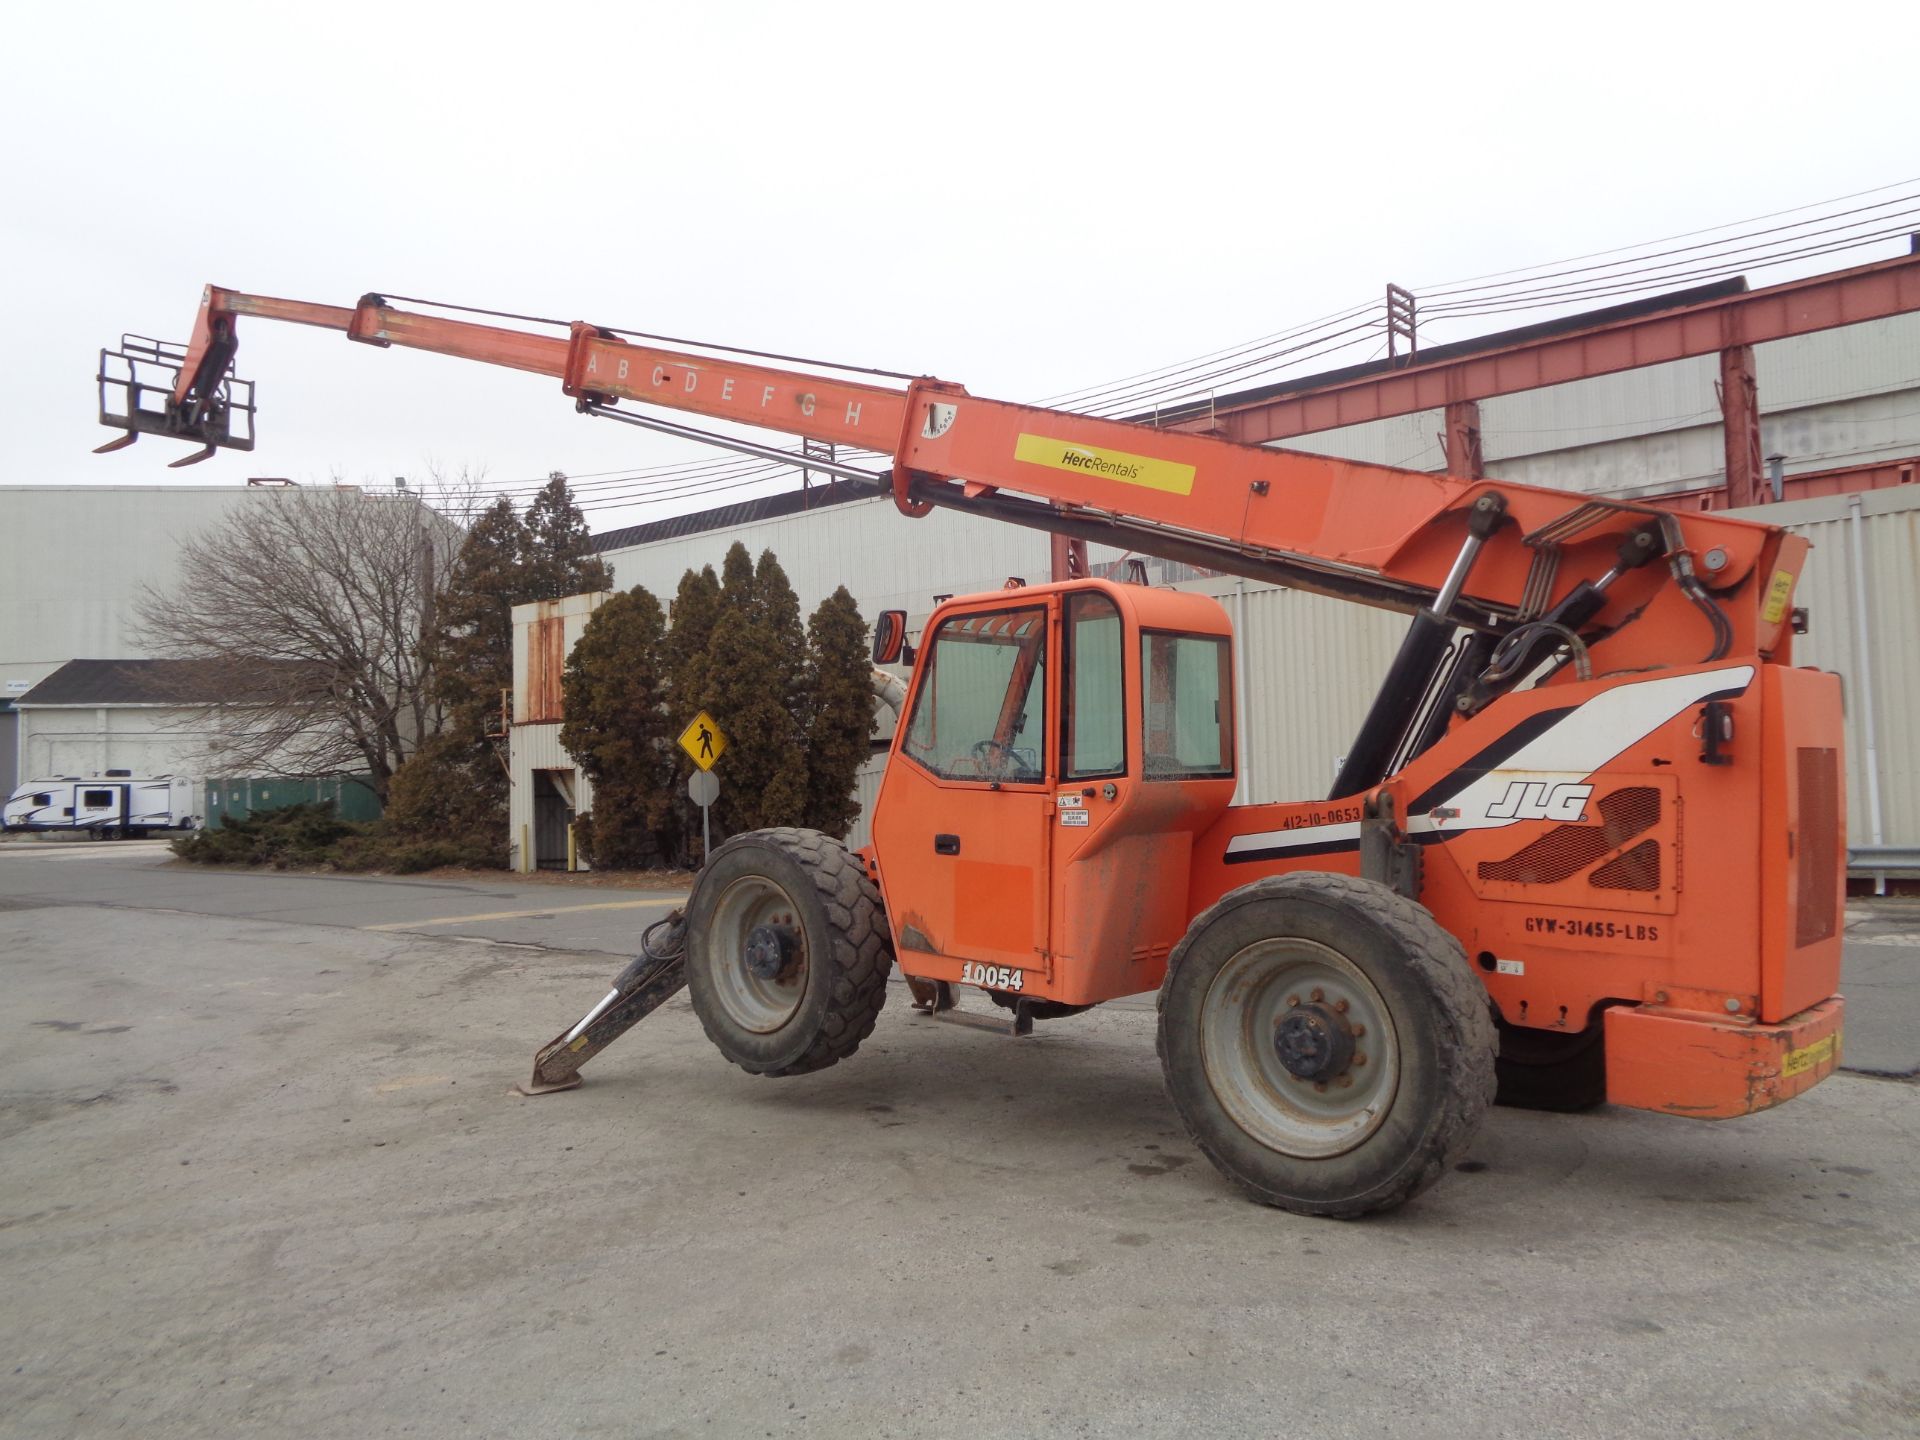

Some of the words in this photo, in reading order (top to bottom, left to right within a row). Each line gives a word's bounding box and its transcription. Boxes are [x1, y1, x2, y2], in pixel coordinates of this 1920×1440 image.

[586, 353, 597, 374] A
[617, 359, 629, 380] B
[652, 366, 664, 387] C
[684, 371, 697, 393] D
[722, 378, 735, 401] E
[761, 385, 775, 408] F
[801, 393, 816, 417] G
[845, 401, 862, 426] H
[1283, 807, 1361, 830] 412-10-0653
[1484, 781, 1595, 822] JLG
[961, 961, 1023, 991] 10054
